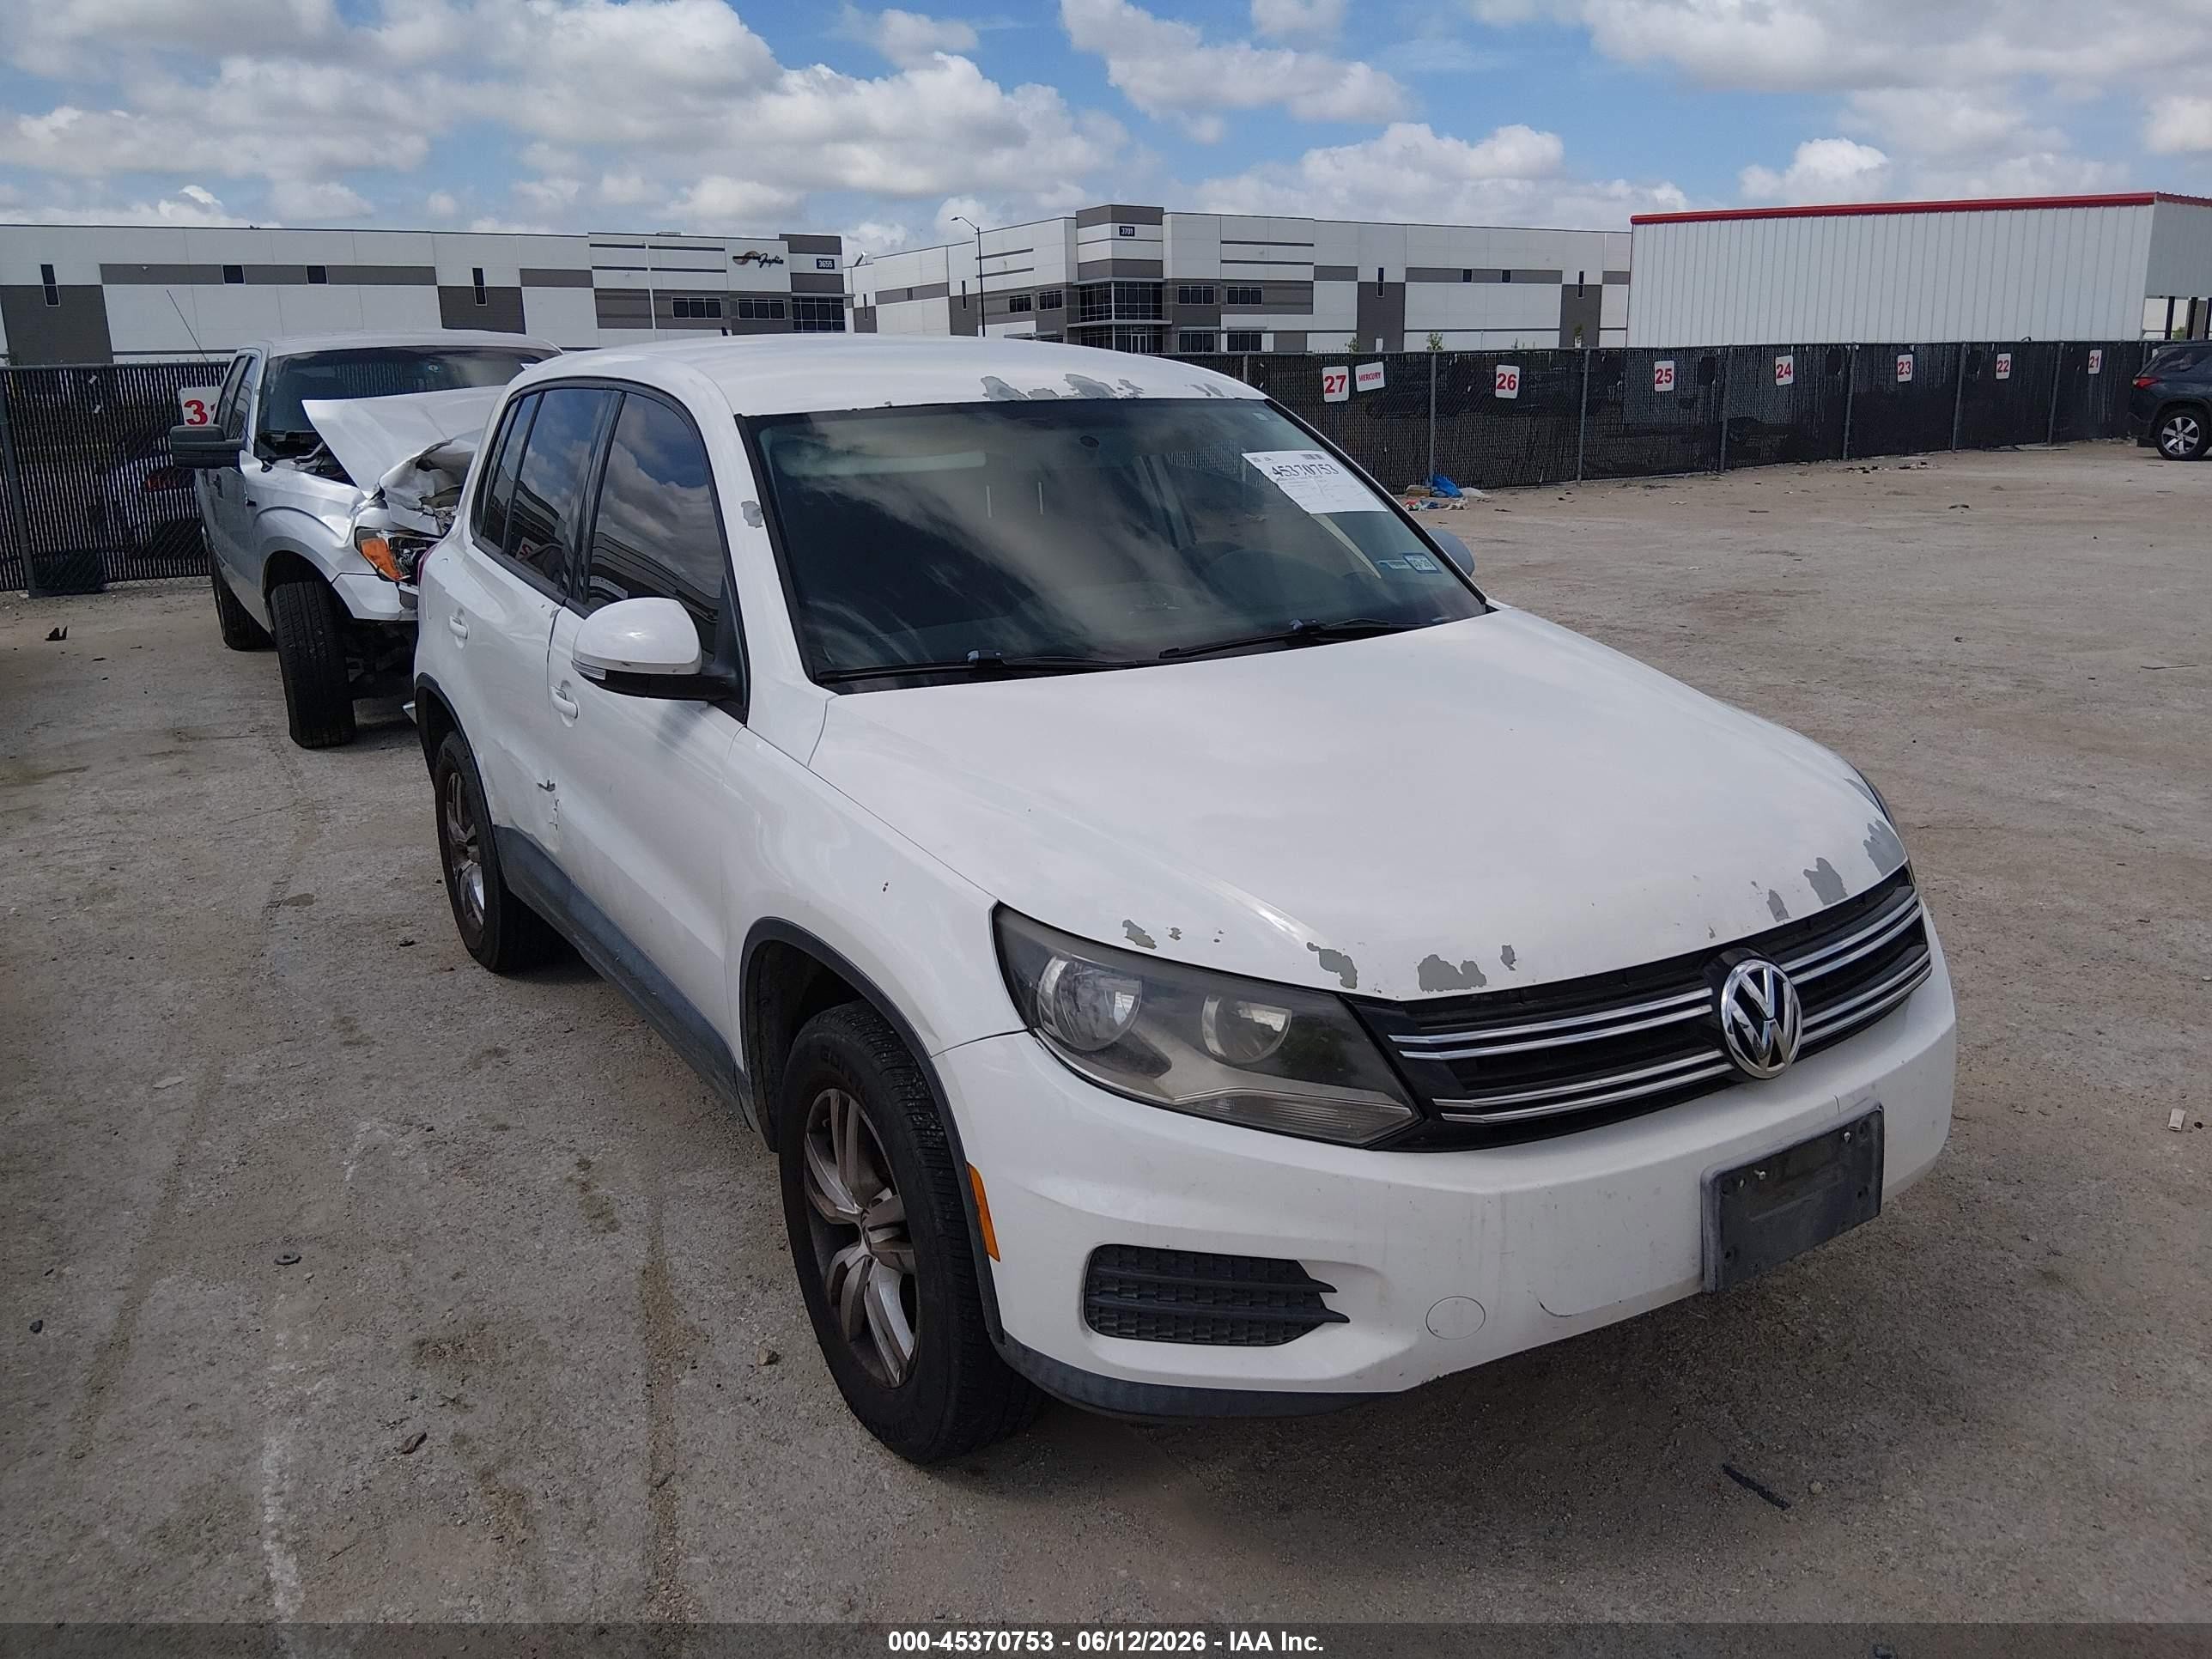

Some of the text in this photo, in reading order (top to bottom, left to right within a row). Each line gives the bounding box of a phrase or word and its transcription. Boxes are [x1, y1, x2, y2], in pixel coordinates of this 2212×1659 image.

[818, 259, 833, 268] 3655
[1899, 362, 1911, 375] 23
[1997, 360, 2009, 373] 22
[2089, 356, 2100, 368] 21
[1358, 371, 1381, 382] MERCURY
[1656, 368, 1673, 384] 25
[1777, 362, 1792, 379] 24
[1324, 374, 1346, 394] 27
[1497, 373, 1516, 391] 26
[184, 399, 216, 426] 3
[1272, 465, 1339, 477] 45370753
